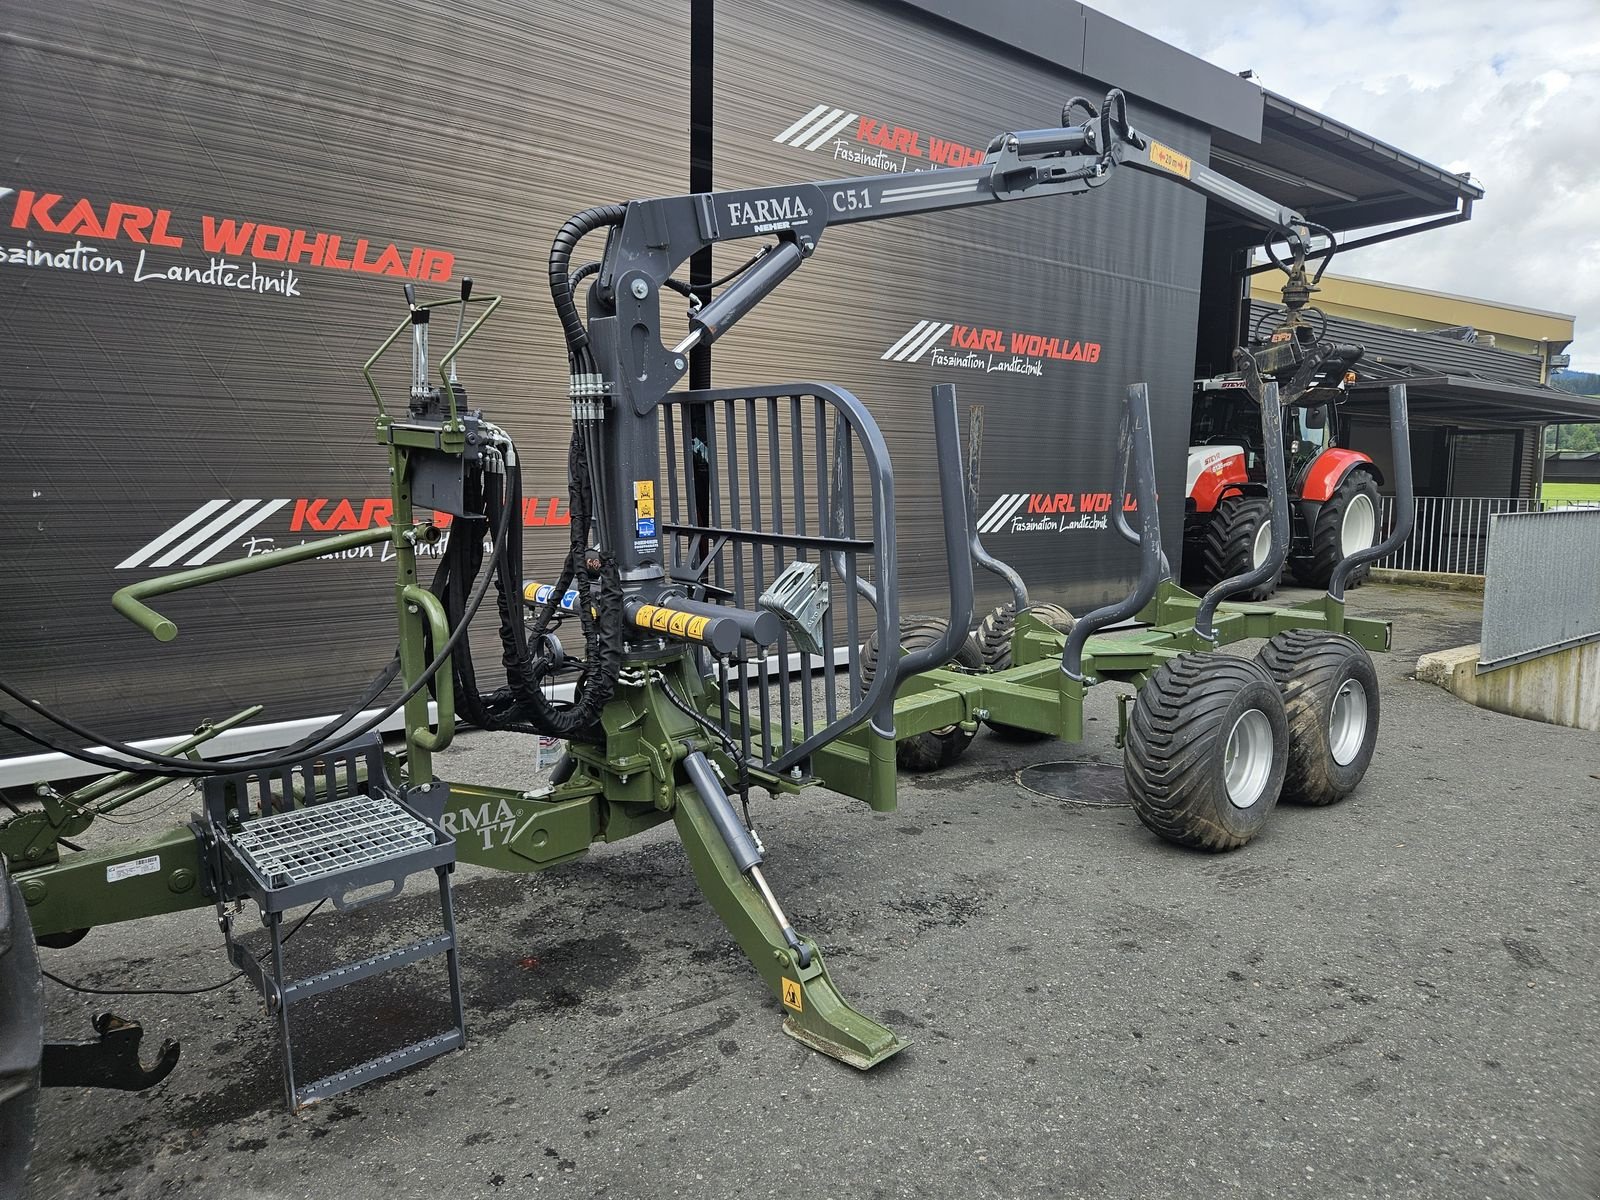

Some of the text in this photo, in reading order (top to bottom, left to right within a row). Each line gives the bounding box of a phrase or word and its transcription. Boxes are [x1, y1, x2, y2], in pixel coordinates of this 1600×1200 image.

[855, 115, 922, 157] KARL
[833, 138, 898, 173] Faszination
[727, 195, 809, 226] FARMA
[832, 188, 872, 212] C5.1
[10, 190, 184, 248] KARL
[753, 221, 790, 233] NEHER
[133, 249, 301, 297] Landtechnik
[950, 325, 1006, 353] KARL
[931, 347, 1043, 377] Faszination Landtechnik
[289, 498, 418, 532] KAR
[1027, 493, 1076, 514] KARL
[1011, 514, 1108, 534] Faszination Landtechnik
[476, 818, 517, 851] T7
